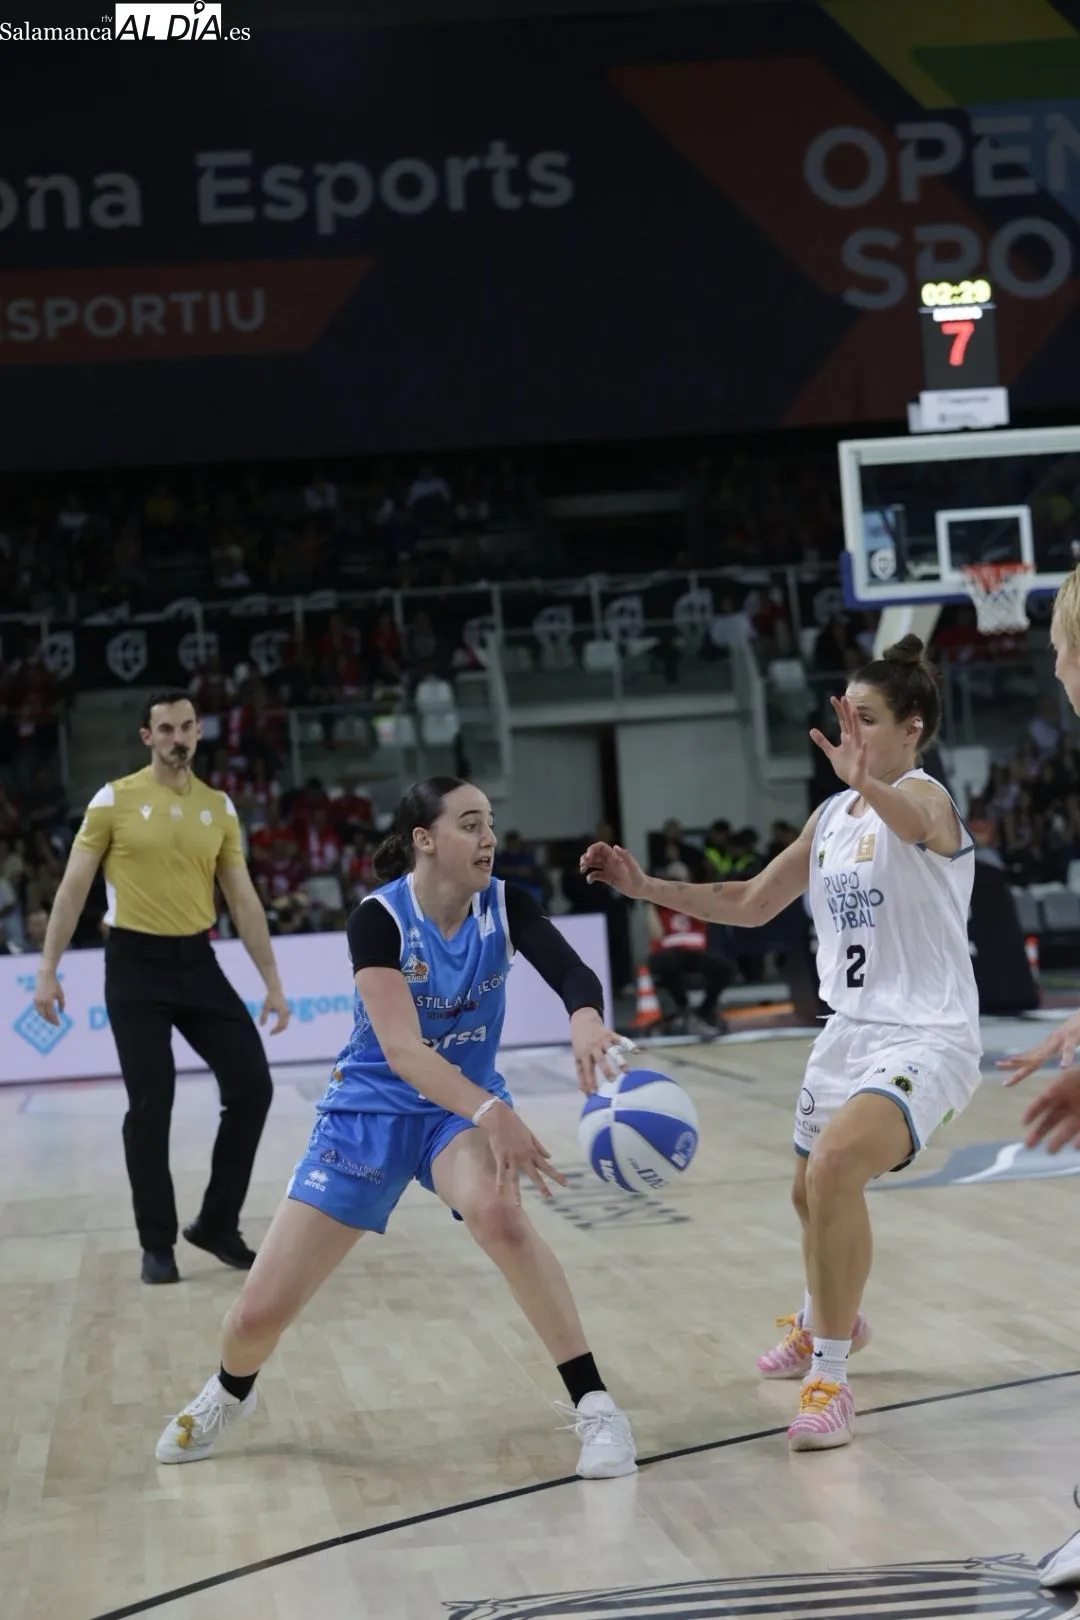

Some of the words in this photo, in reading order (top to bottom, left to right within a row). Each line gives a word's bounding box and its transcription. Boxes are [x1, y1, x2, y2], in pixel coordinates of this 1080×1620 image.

[0, 171, 142, 231] na
[195, 139, 574, 235] Esports
[0, 288, 267, 342] SPORTIU
[941, 320, 975, 366] 7
[846, 944, 866, 988] 2
